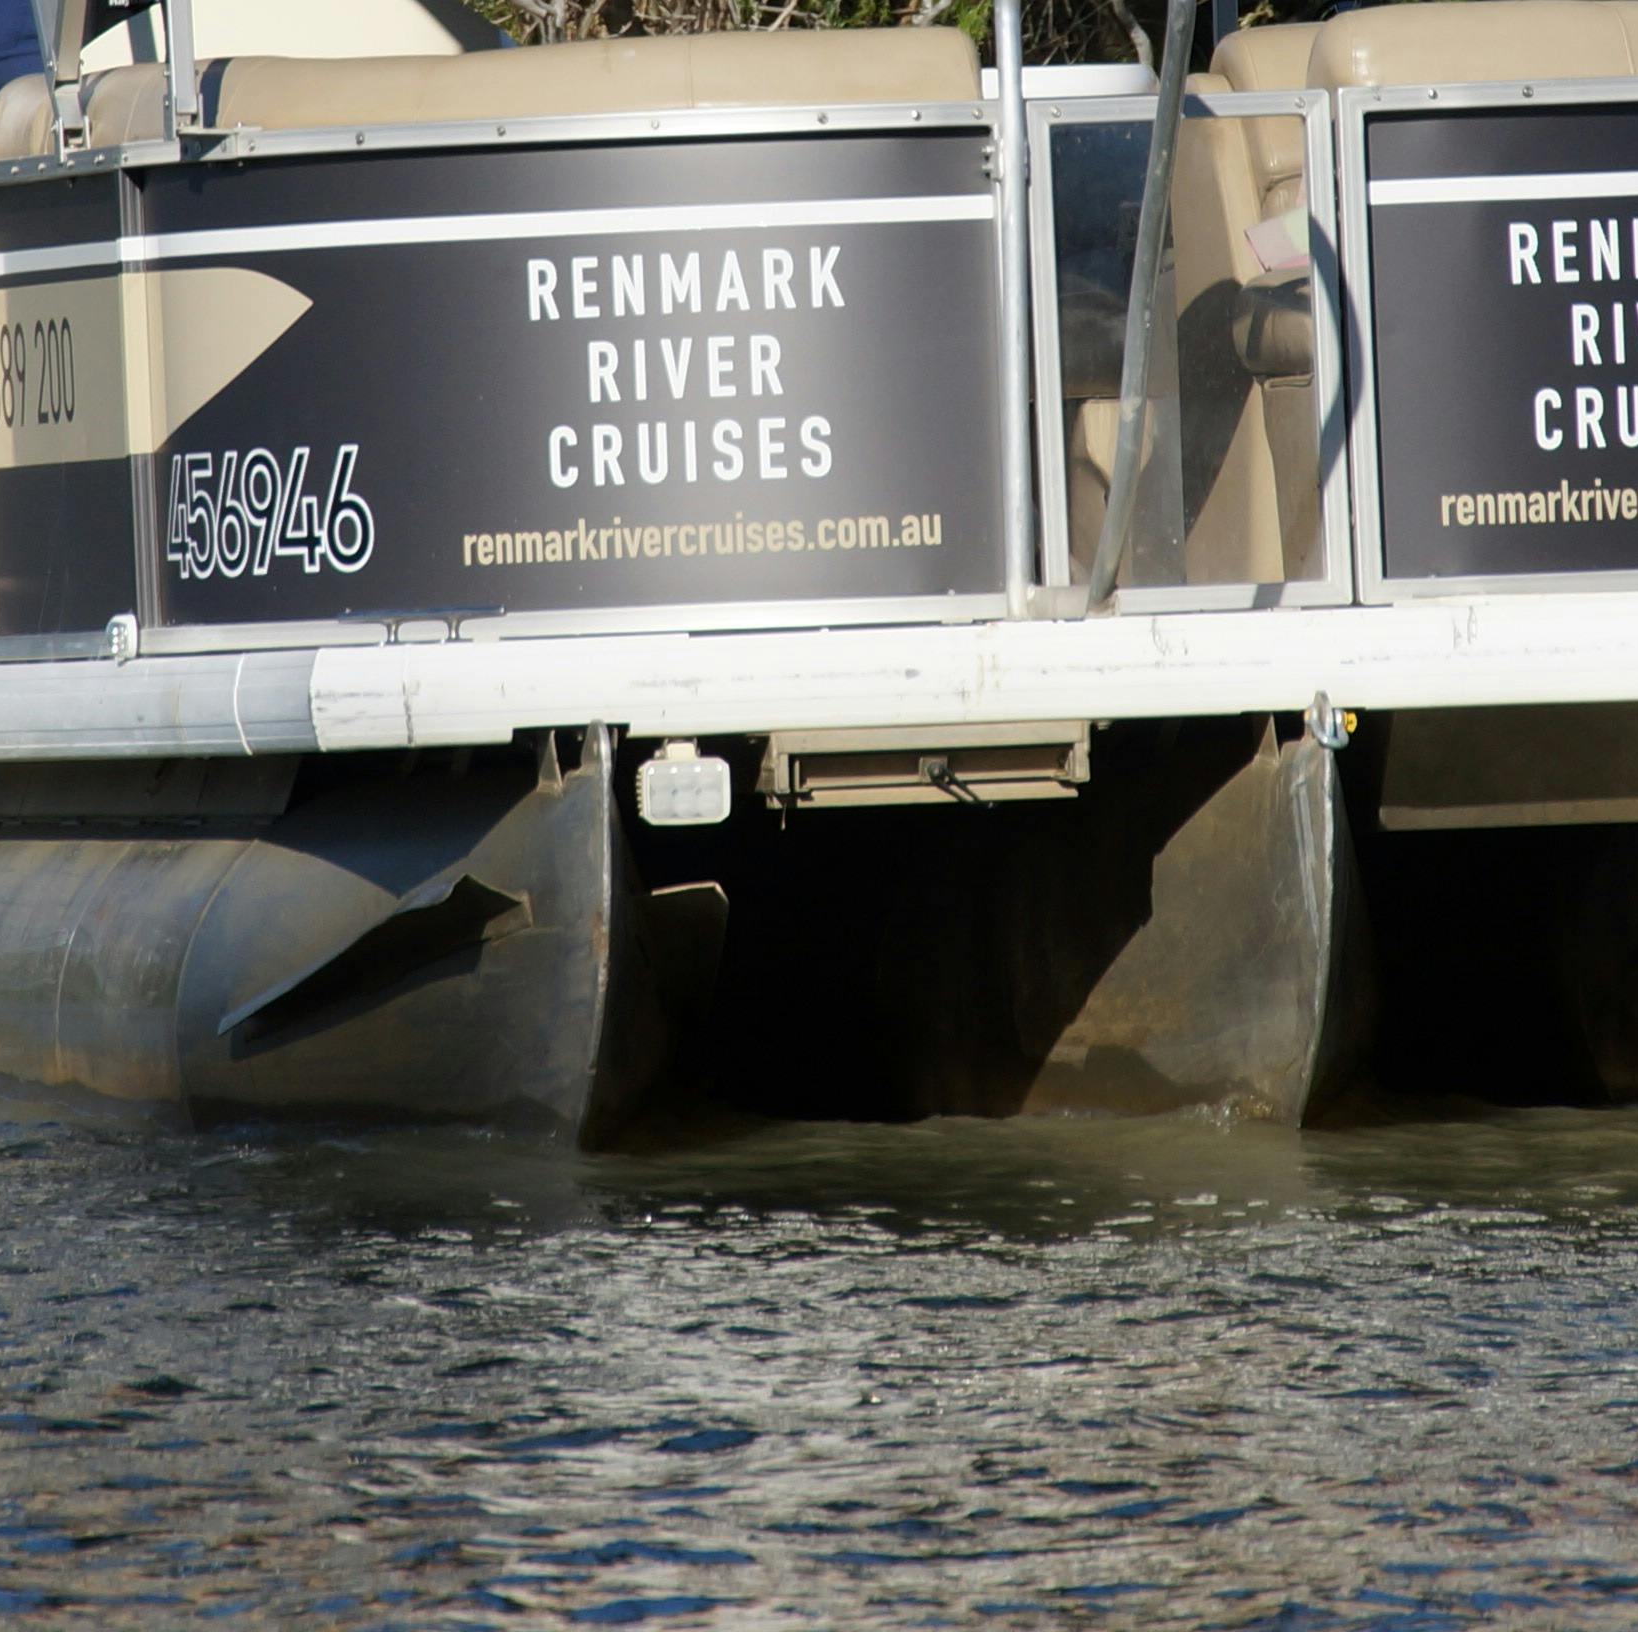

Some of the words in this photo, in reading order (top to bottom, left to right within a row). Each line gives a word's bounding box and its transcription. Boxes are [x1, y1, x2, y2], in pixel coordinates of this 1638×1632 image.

[525, 245, 847, 322] RENMARK
[34, 316, 75, 424] 200
[587, 333, 786, 404] RIVER
[547, 415, 834, 489] CRUISES
[167, 444, 375, 579] 456946
[463, 508, 943, 567] renmarkrivercruises.com.au
